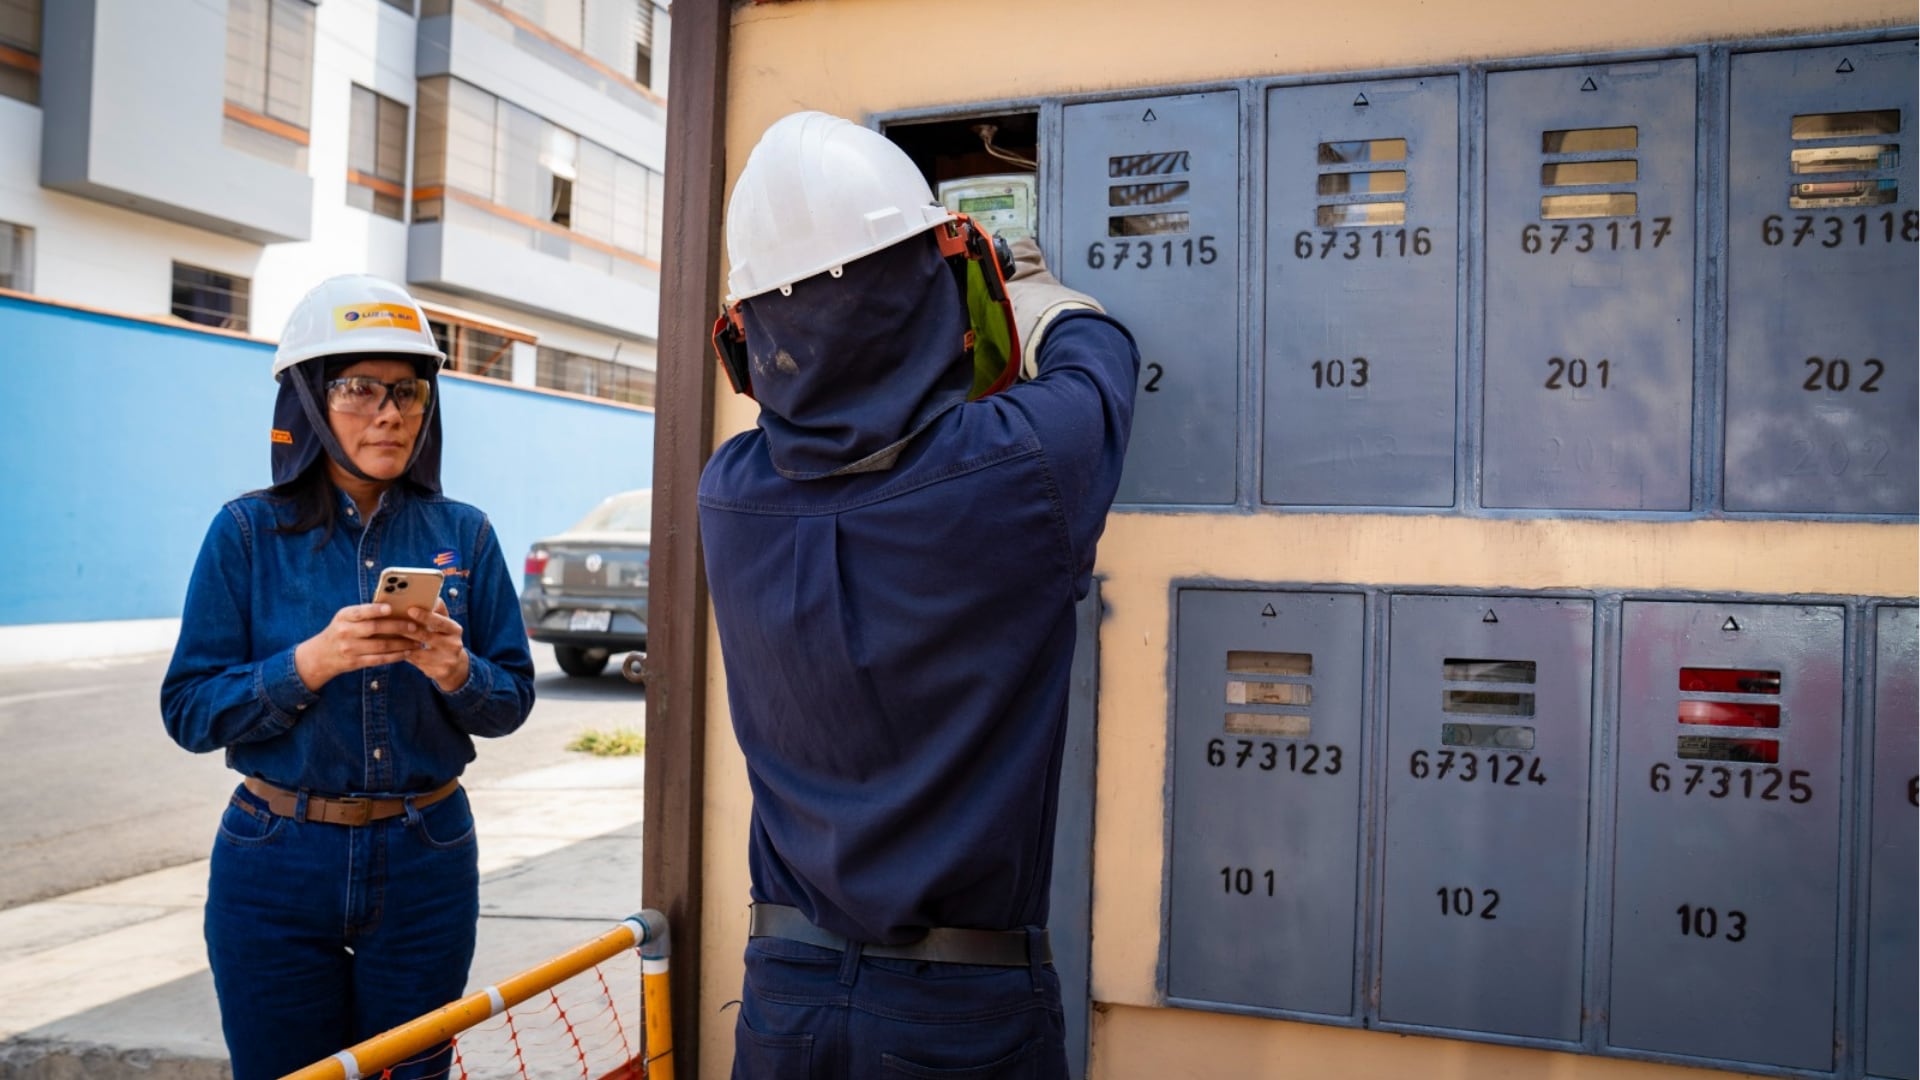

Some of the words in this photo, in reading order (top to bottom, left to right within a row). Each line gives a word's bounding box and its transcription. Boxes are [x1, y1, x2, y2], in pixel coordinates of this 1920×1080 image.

[1294, 227, 1432, 260] 673116
[1521, 217, 1672, 254] 673117
[1762, 210, 1919, 248] 673118
[1087, 235, 1218, 270] 673115
[1311, 357, 1371, 389] 103
[1543, 357, 1610, 390] 201
[1802, 356, 1886, 393] 202
[1207, 739, 1343, 775] 673123
[1410, 750, 1548, 786] 673124
[1649, 762, 1813, 803] 673125
[1220, 866, 1276, 897] 101
[1436, 886, 1501, 920] 102
[1676, 903, 1748, 942] 103
